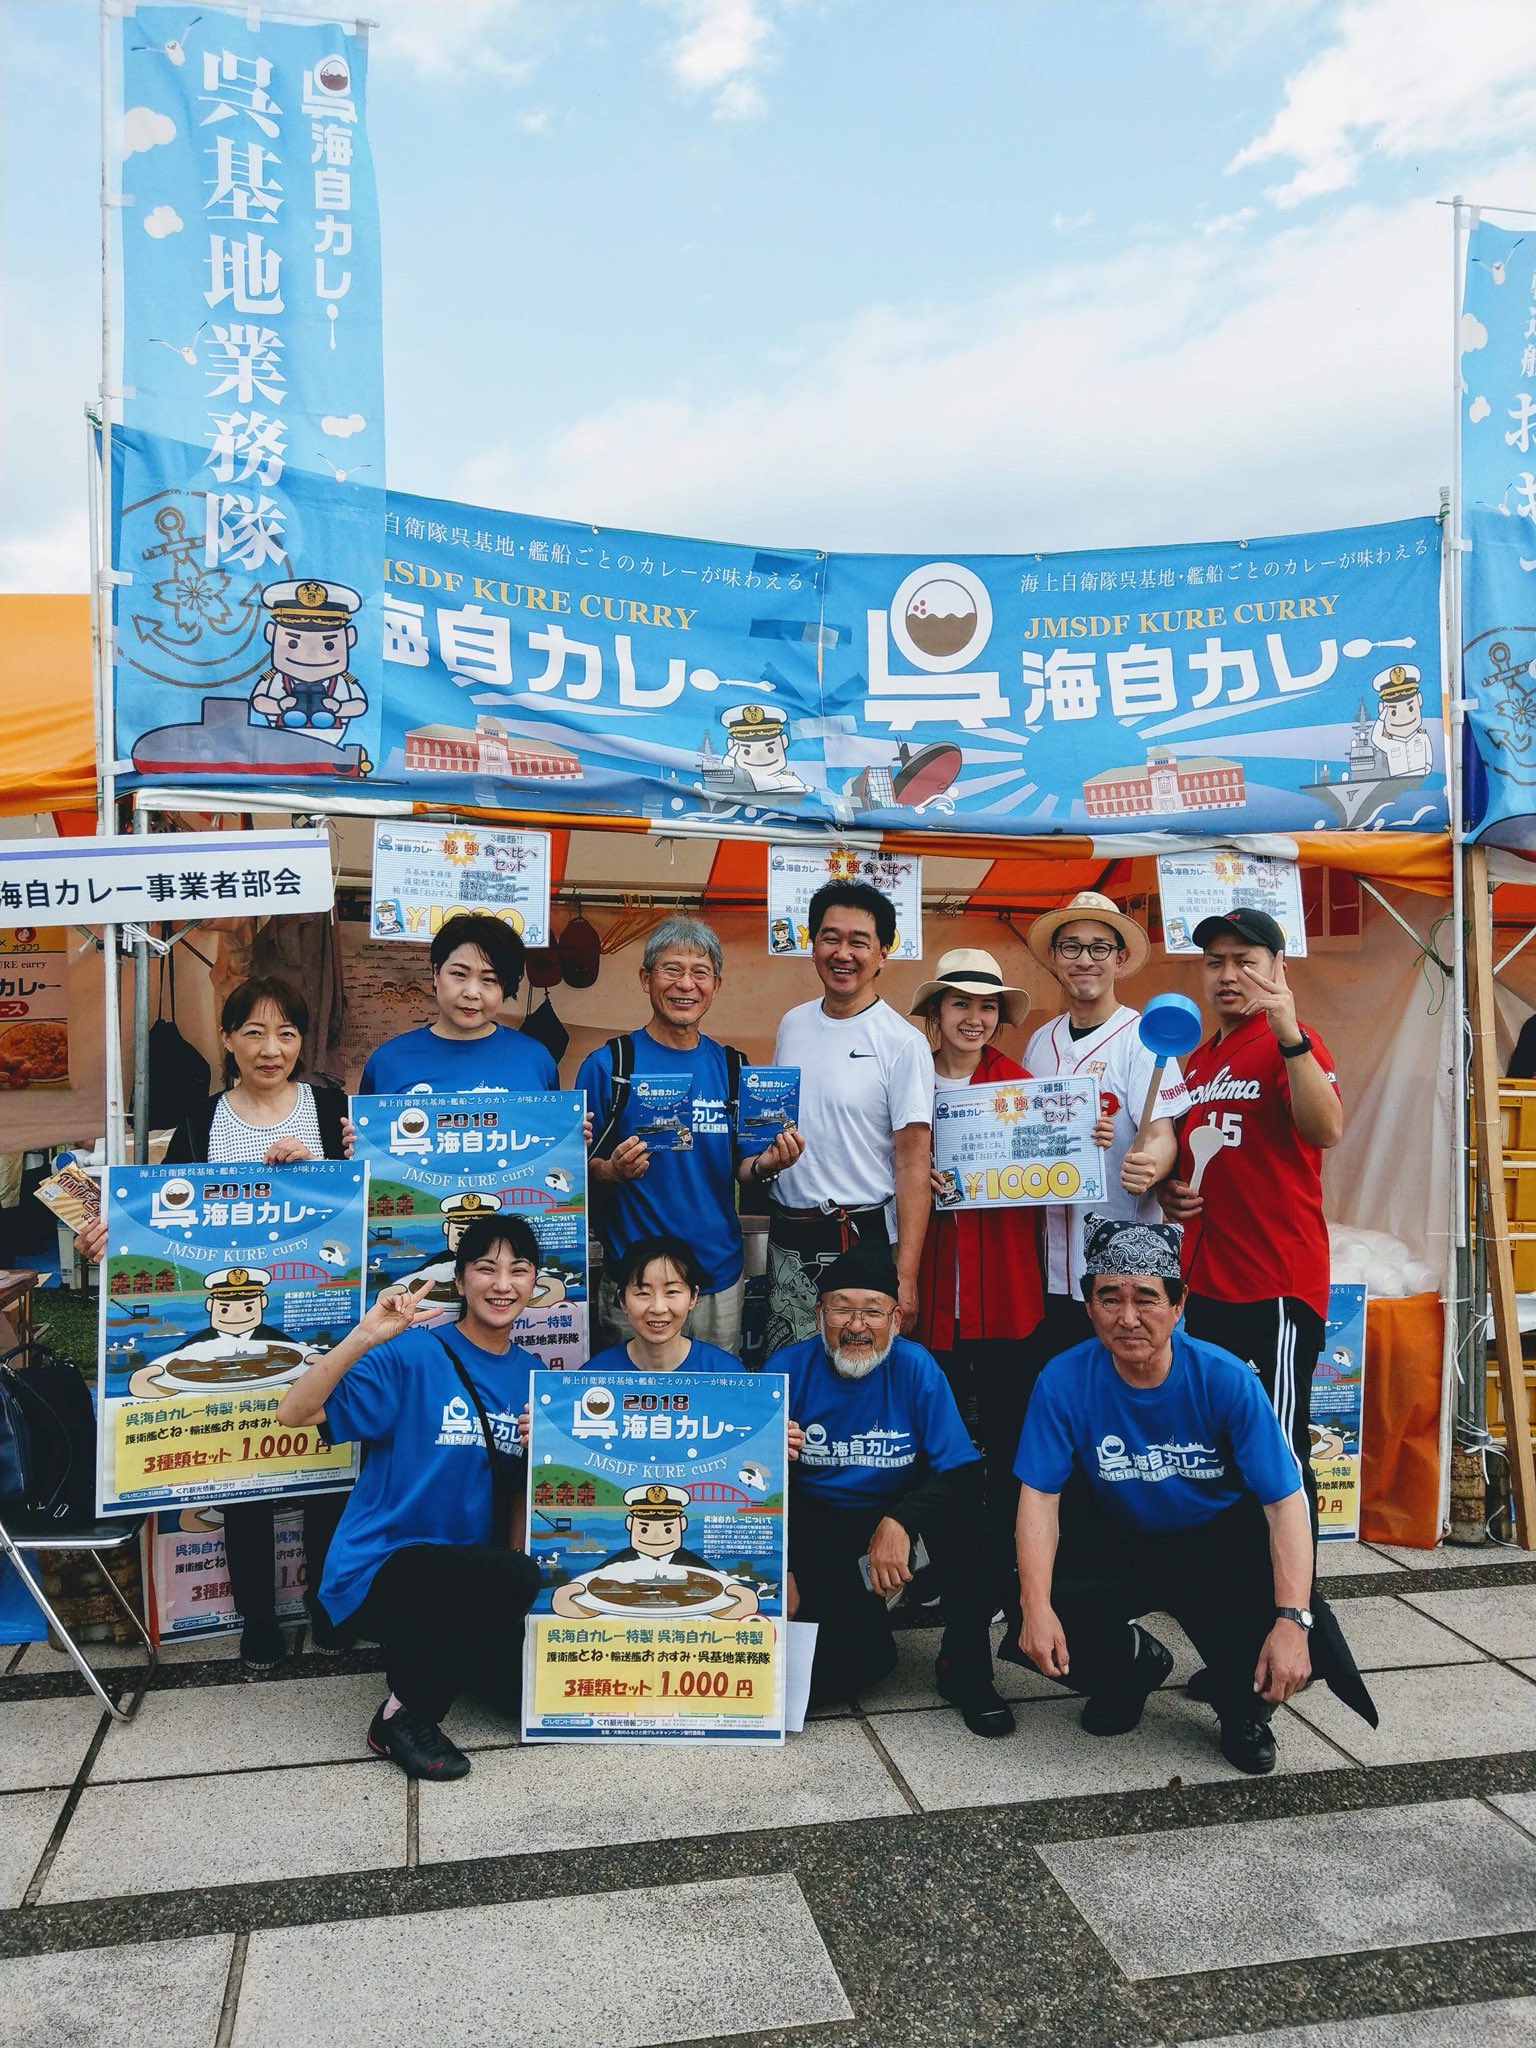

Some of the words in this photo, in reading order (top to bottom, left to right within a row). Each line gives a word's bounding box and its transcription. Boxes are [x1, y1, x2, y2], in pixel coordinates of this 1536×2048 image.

[196, 48, 289, 572] 呉基地業務隊
[384, 557, 463, 593] SDF
[473, 576, 570, 615] KURE
[579, 593, 699, 631] CURRY
[1024, 613, 1130, 640] JMSDF
[1138, 605, 1226, 634] KURE
[1235, 594, 1341, 625] CURRY
[494, 860, 527, 872] セット
[0, 961, 17, 969] RE
[1032, 1092, 1088, 1109] 食べ比べ
[436, 1112, 499, 1128] 2018
[1043, 1110, 1077, 1123] セット
[1208, 1111, 1243, 1148] 15
[402, 1167, 453, 1187] JMSDF
[456, 1174, 498, 1188] KURE
[502, 1165, 536, 1183] curry
[964, 1161, 1081, 1199] ¥1000
[202, 1182, 272, 1200] 2018
[163, 1240, 219, 1263] JMSDF
[223, 1247, 268, 1263] KURE
[272, 1237, 309, 1257] curry
[511, 1314, 573, 1330] カレー特製
[622, 1393, 690, 1411] 2018
[143, 1447, 232, 1473] 3種類セット
[242, 1432, 309, 1460] 1,000
[315, 1438, 331, 1453] 円
[584, 1451, 639, 1477] JMSDF
[642, 1464, 686, 1479] KURE
[691, 1456, 729, 1475] curry
[1331, 1499, 1343, 1513] 円
[547, 1628, 653, 1644] 呉海自カレー特製
[658, 1629, 763, 1646] 呉海自カレー特製
[564, 1678, 652, 1697] 3種類セット
[661, 1670, 728, 1697] 1,000
[736, 1679, 753, 1697] 円
